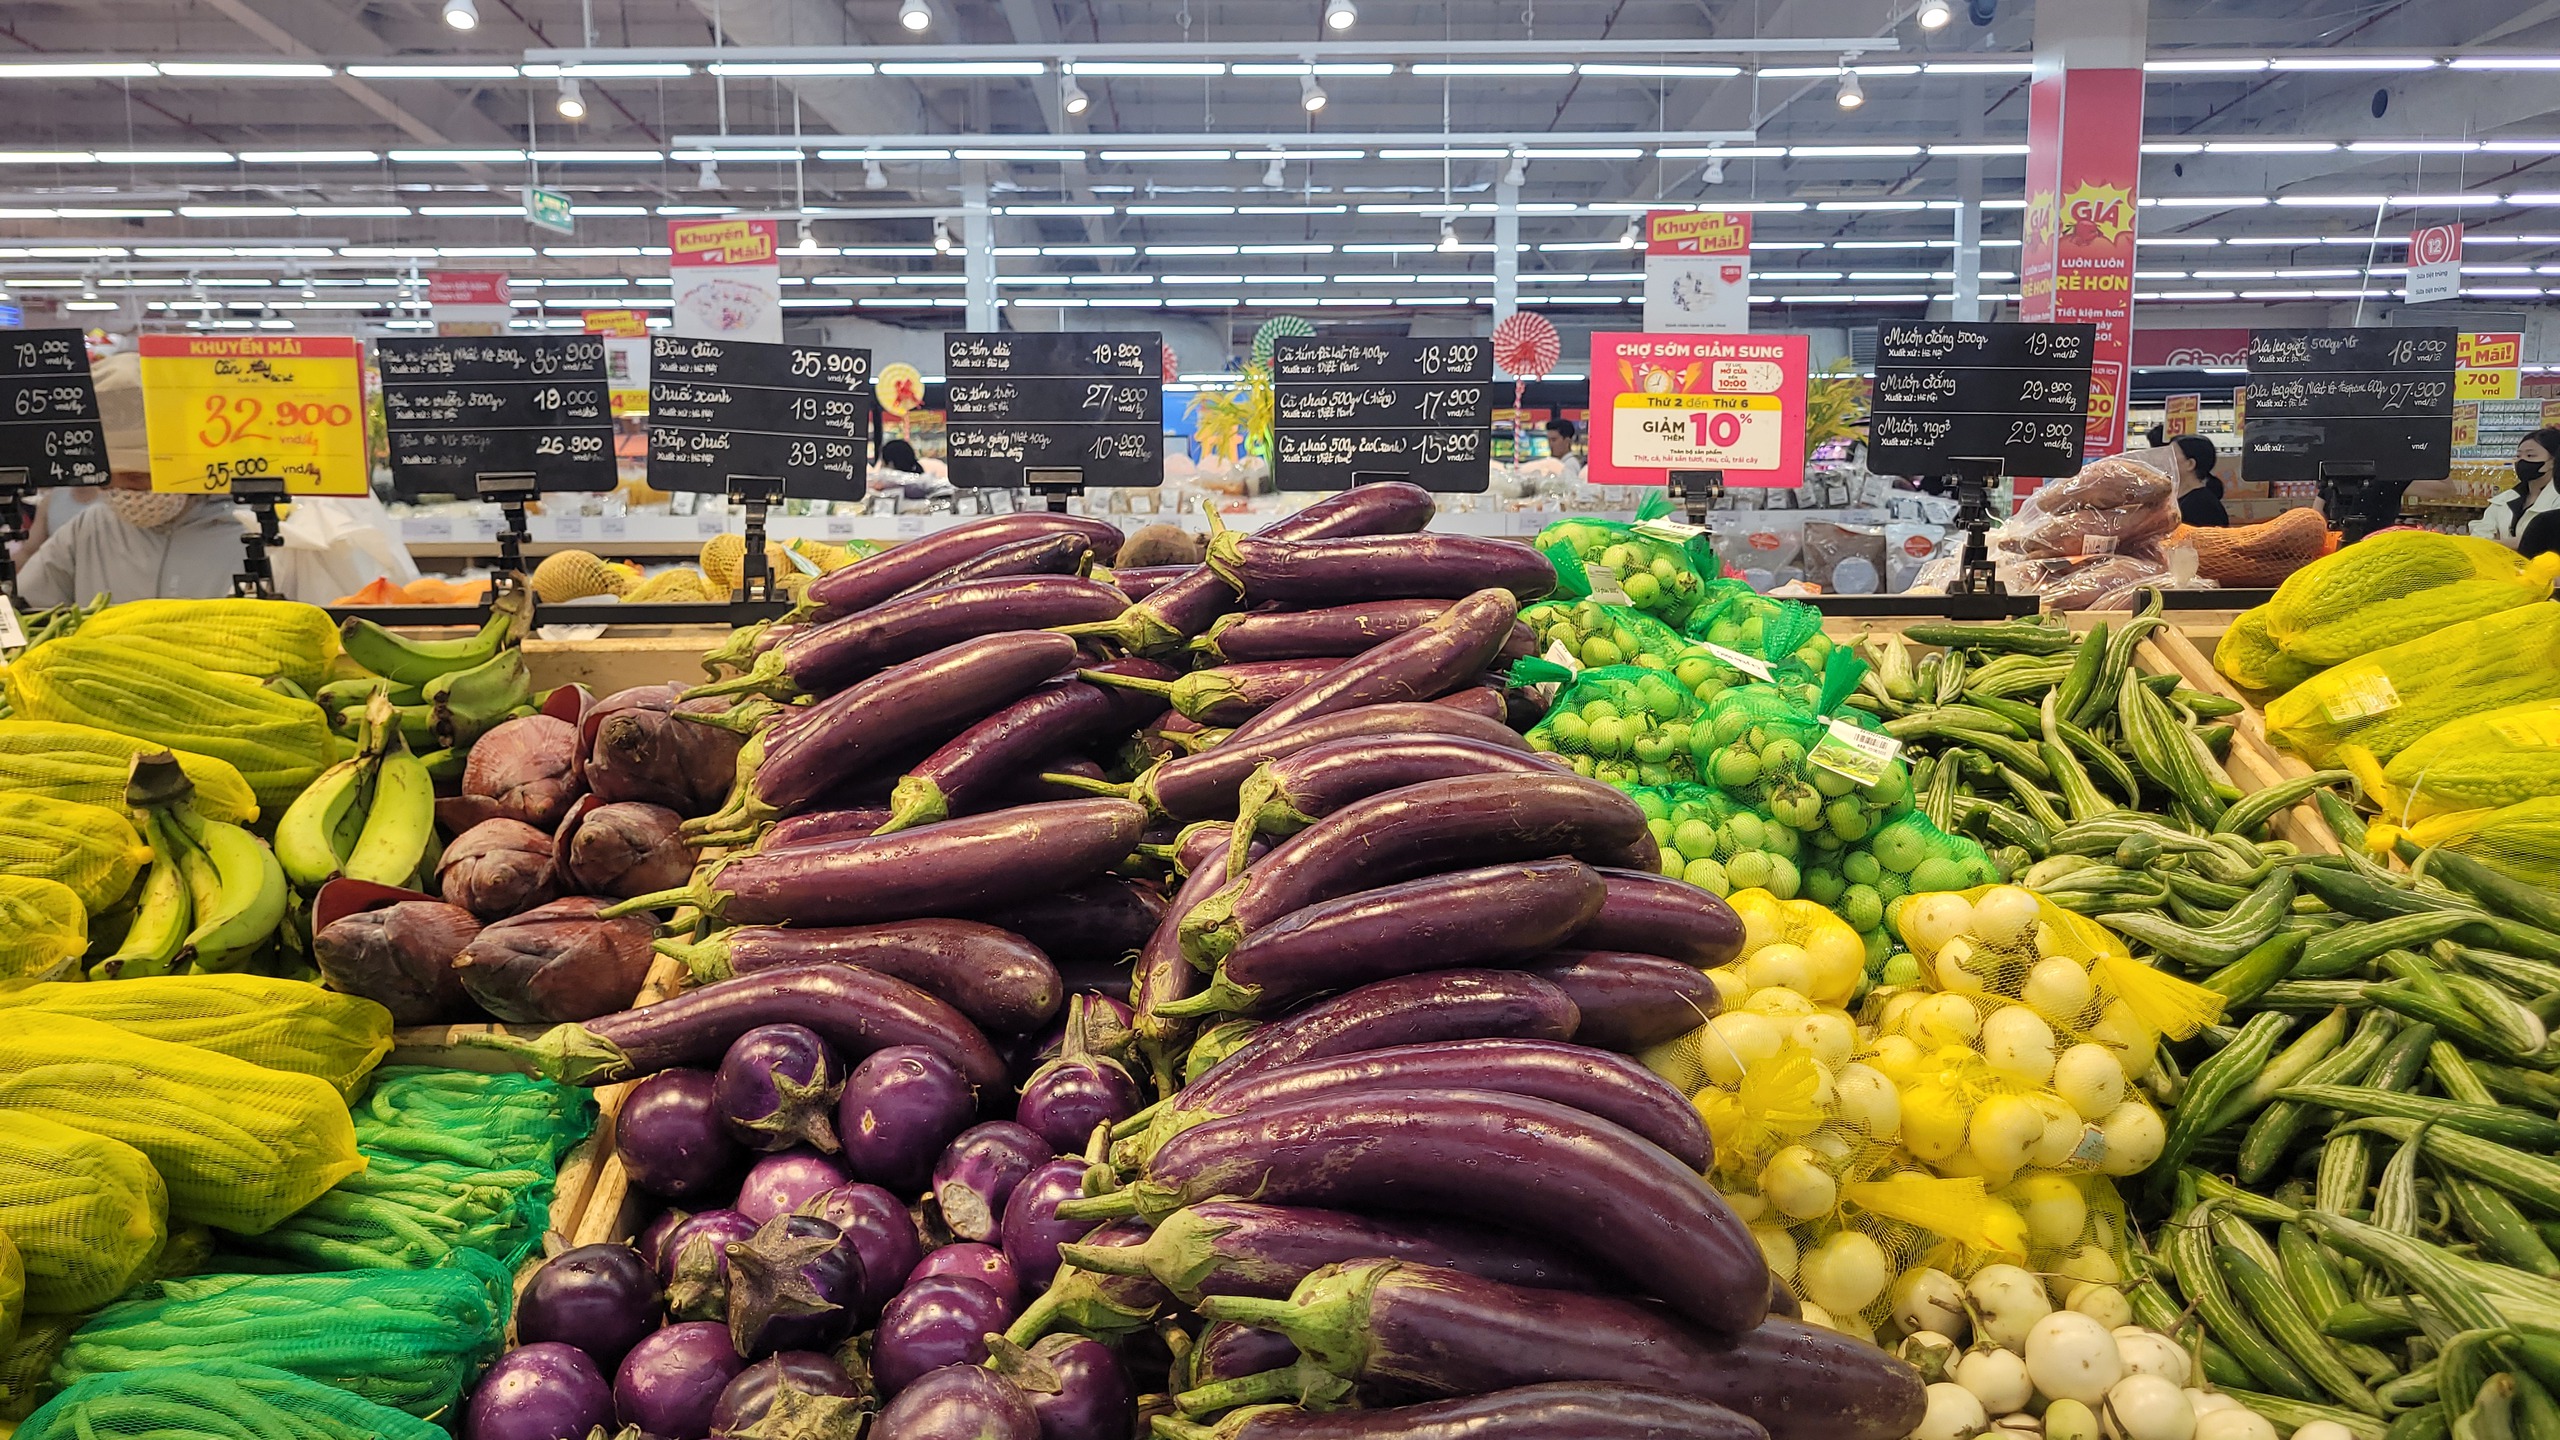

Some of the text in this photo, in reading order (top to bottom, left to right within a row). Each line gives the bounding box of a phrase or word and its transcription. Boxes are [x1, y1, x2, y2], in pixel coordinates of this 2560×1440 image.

[2070, 198, 2124, 229] GIÁ
[1656, 214, 1719, 235] Khuyến
[679, 228, 744, 246] Khuyến
[730, 237, 766, 258] Mãi!
[1704, 228, 1740, 249] Mãi!
[2427, 238, 2442, 255] 12
[2061, 257, 2125, 269] LUÔN LUÔN
[2056, 270, 2129, 292] RẺ HƠN
[2056, 307, 2077, 317] Tiết
[2078, 307, 2103, 318] kiệm
[2105, 308, 2125, 318] hơn
[190, 337, 301, 355] KHUYẾN MÃI
[653, 338, 688, 359] Đậu
[949, 338, 1012, 357] Cà tím dài
[1883, 325, 1989, 352] Mướp đắng 500gr
[2025, 332, 2080, 355] 19.000
[1278, 346, 1294, 362] Cà
[1295, 343, 1317, 361] tím
[1414, 345, 1478, 374] 18.900
[1615, 341, 1784, 358] CHỢ SỚM GIẢM SUNG
[2388, 340, 2447, 366] 18.000
[2475, 345, 2512, 363] Mãi!
[791, 349, 867, 378] 35.900
[827, 374, 863, 391] vnd/kg
[950, 386, 968, 402] Cà
[968, 382, 991, 402] tím
[1719, 379, 1747, 387] 10:00
[1880, 370, 1956, 396] Mướp đắng
[2020, 380, 2073, 401] 29.900
[2481, 387, 2500, 395] vnd
[15, 387, 83, 415] 65.000
[652, 383, 693, 402] Chuối
[693, 388, 732, 404] xanh
[1082, 383, 1148, 409] 27.900
[1280, 393, 1297, 408] Cà
[1414, 388, 1480, 420] 17.900
[1647, 397, 1749, 408] Thứ 2 đến Thứ 6
[2048, 391, 2077, 412] vnd/kg
[2382, 382, 2447, 411] 27.900
[790, 397, 854, 421] 19.900
[199, 394, 352, 448] 32.900
[825, 418, 855, 437] vnd/kg
[1642, 412, 1753, 447] GIẢM 10%
[1877, 416, 1952, 439] Mướp ngọt
[691, 432, 730, 450] chuối
[950, 431, 966, 446] Cà
[967, 428, 987, 445] tím
[1278, 435, 1295, 453] Cà
[2005, 421, 2073, 446] 29.900
[536, 436, 603, 455] 26.900
[787, 441, 852, 467] 39.900
[1088, 434, 1146, 460] 10.900
[1412, 433, 1478, 464] 15.900
[2043, 437, 2073, 459] vnd/kg
[823, 461, 854, 480] vnd/kg
[1746, 456, 1758, 464] cây
[204, 457, 268, 490] 35.000
